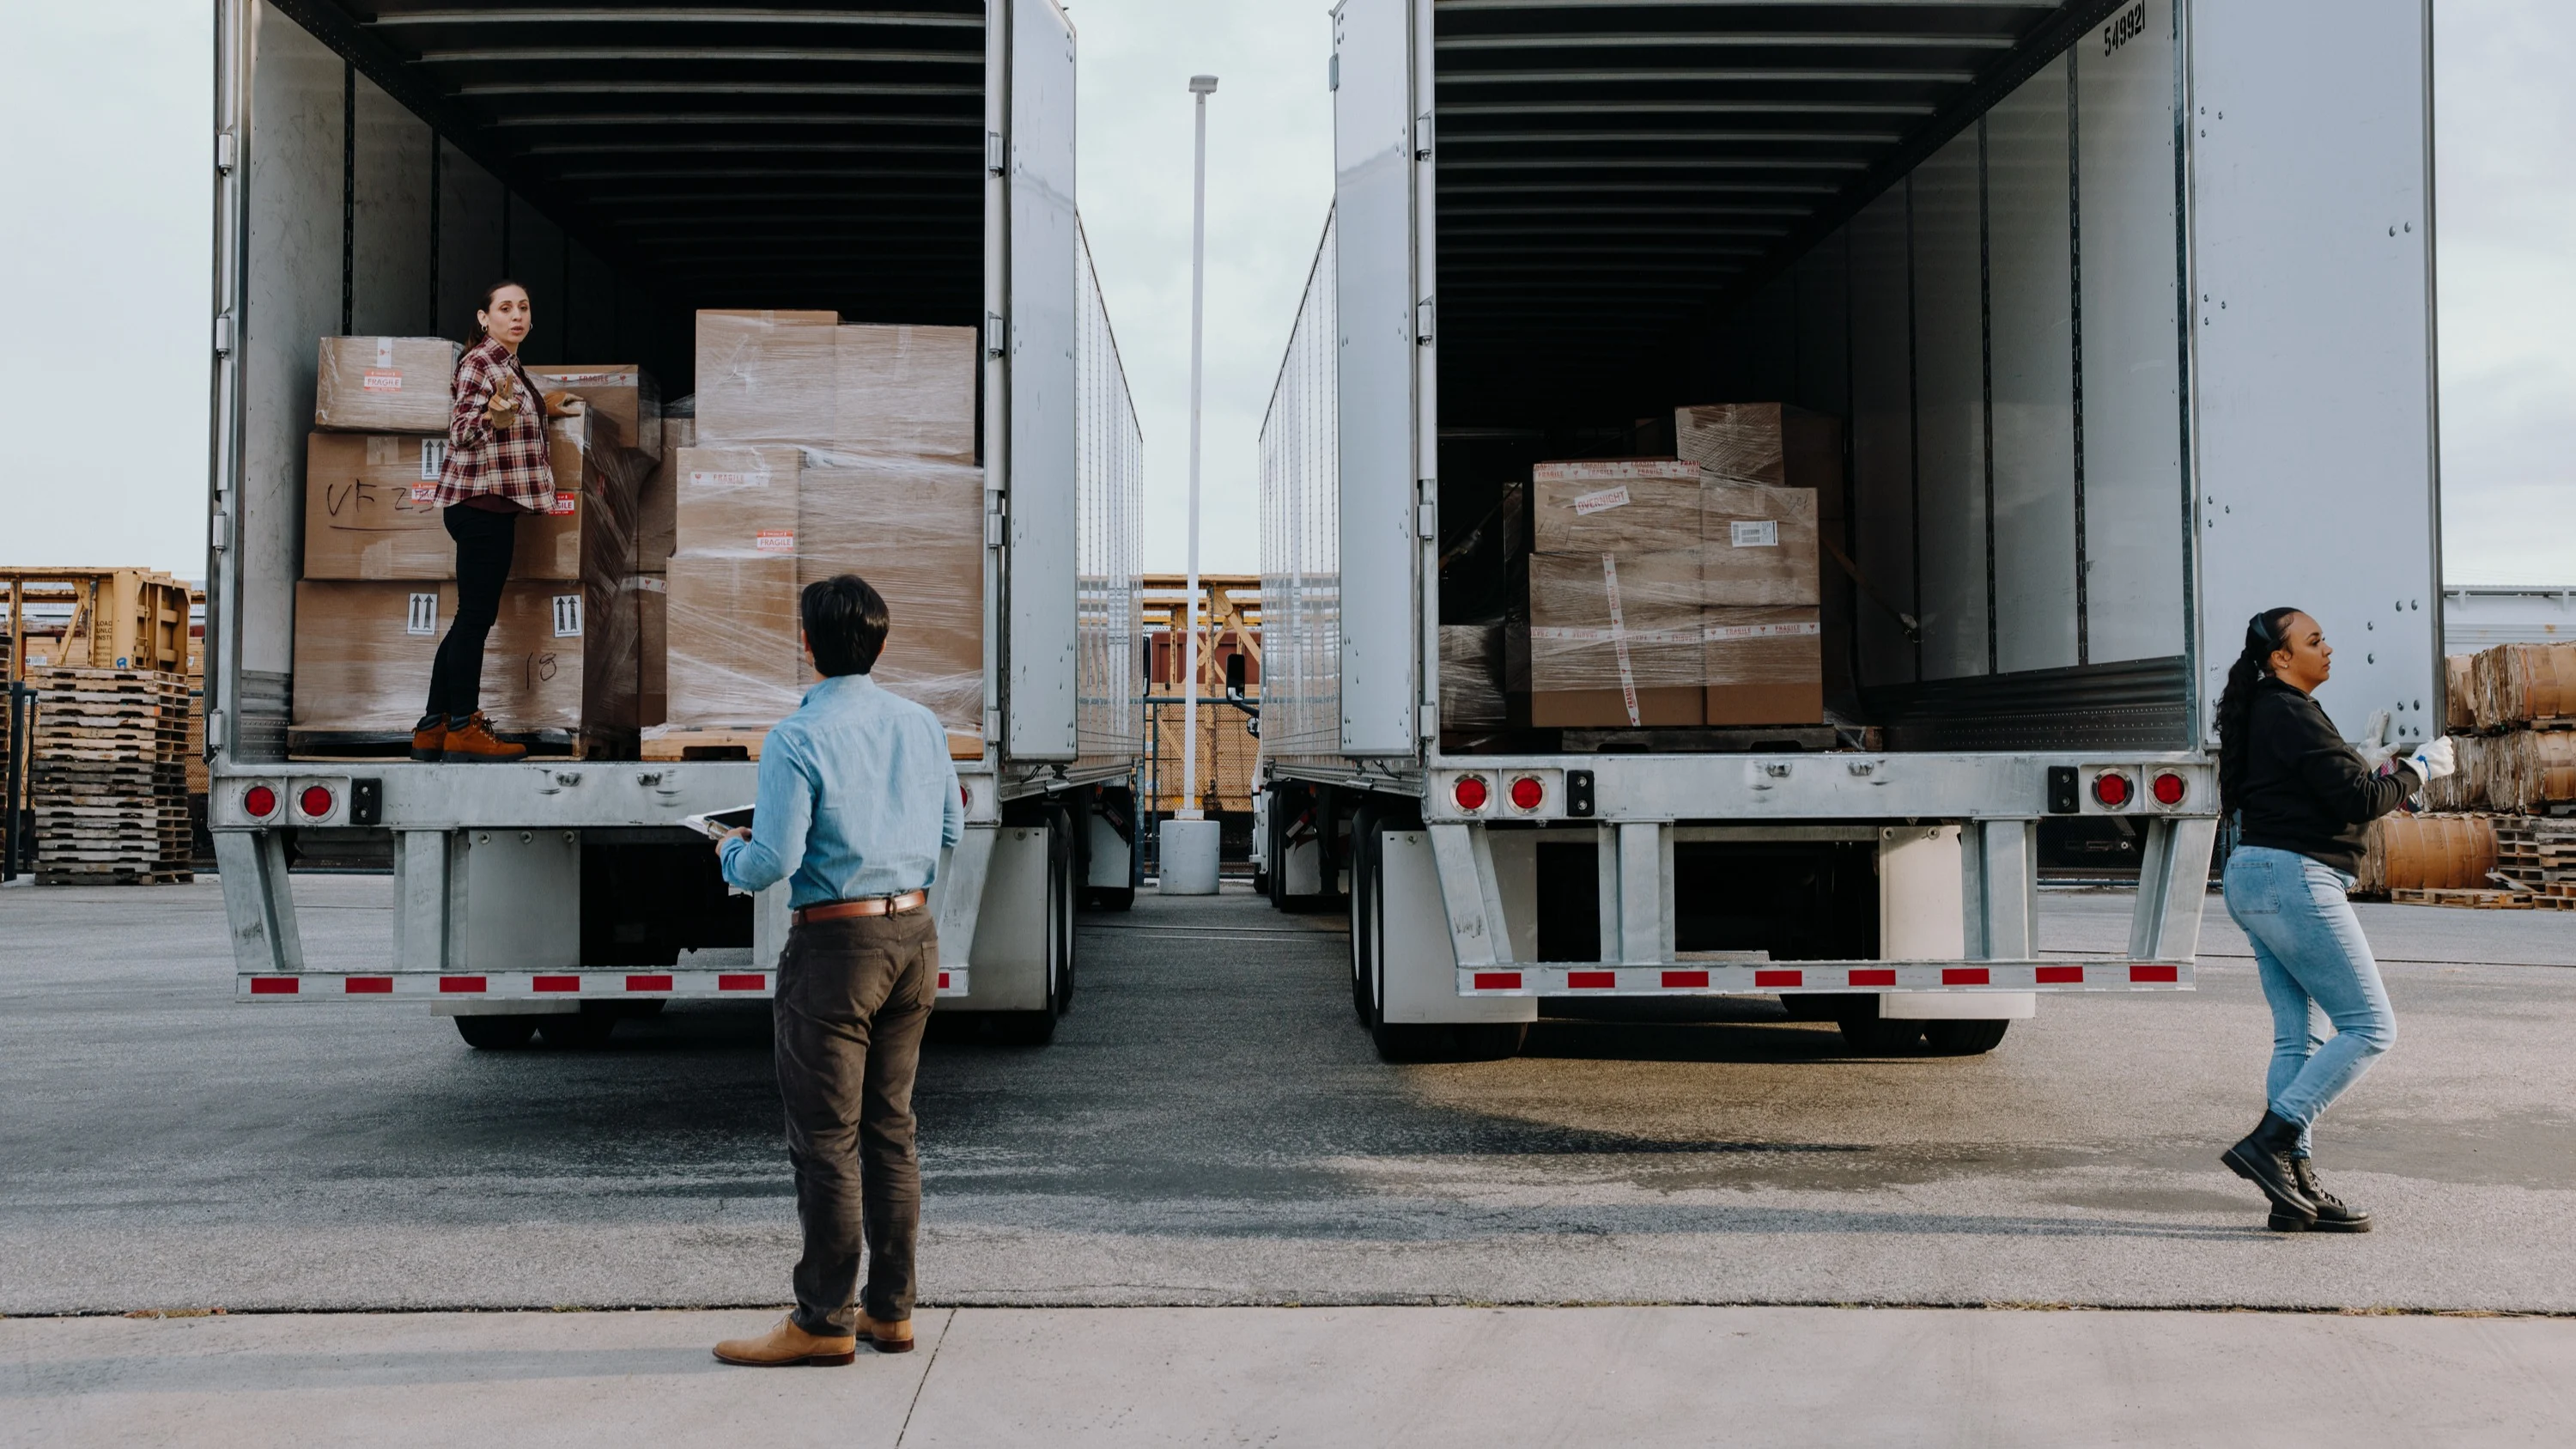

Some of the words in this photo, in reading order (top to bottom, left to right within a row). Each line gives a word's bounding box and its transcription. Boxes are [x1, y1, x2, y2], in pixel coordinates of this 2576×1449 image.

[2104, 0, 2145, 58] 549921
[368, 378, 400, 387] FRAGILE
[327, 478, 377, 516] VF
[415, 490, 436, 499] FRAG
[1577, 490, 1625, 511] OVERNIGHT
[526, 651, 557, 691] 18
[1625, 683, 1634, 709] FRAGILE
